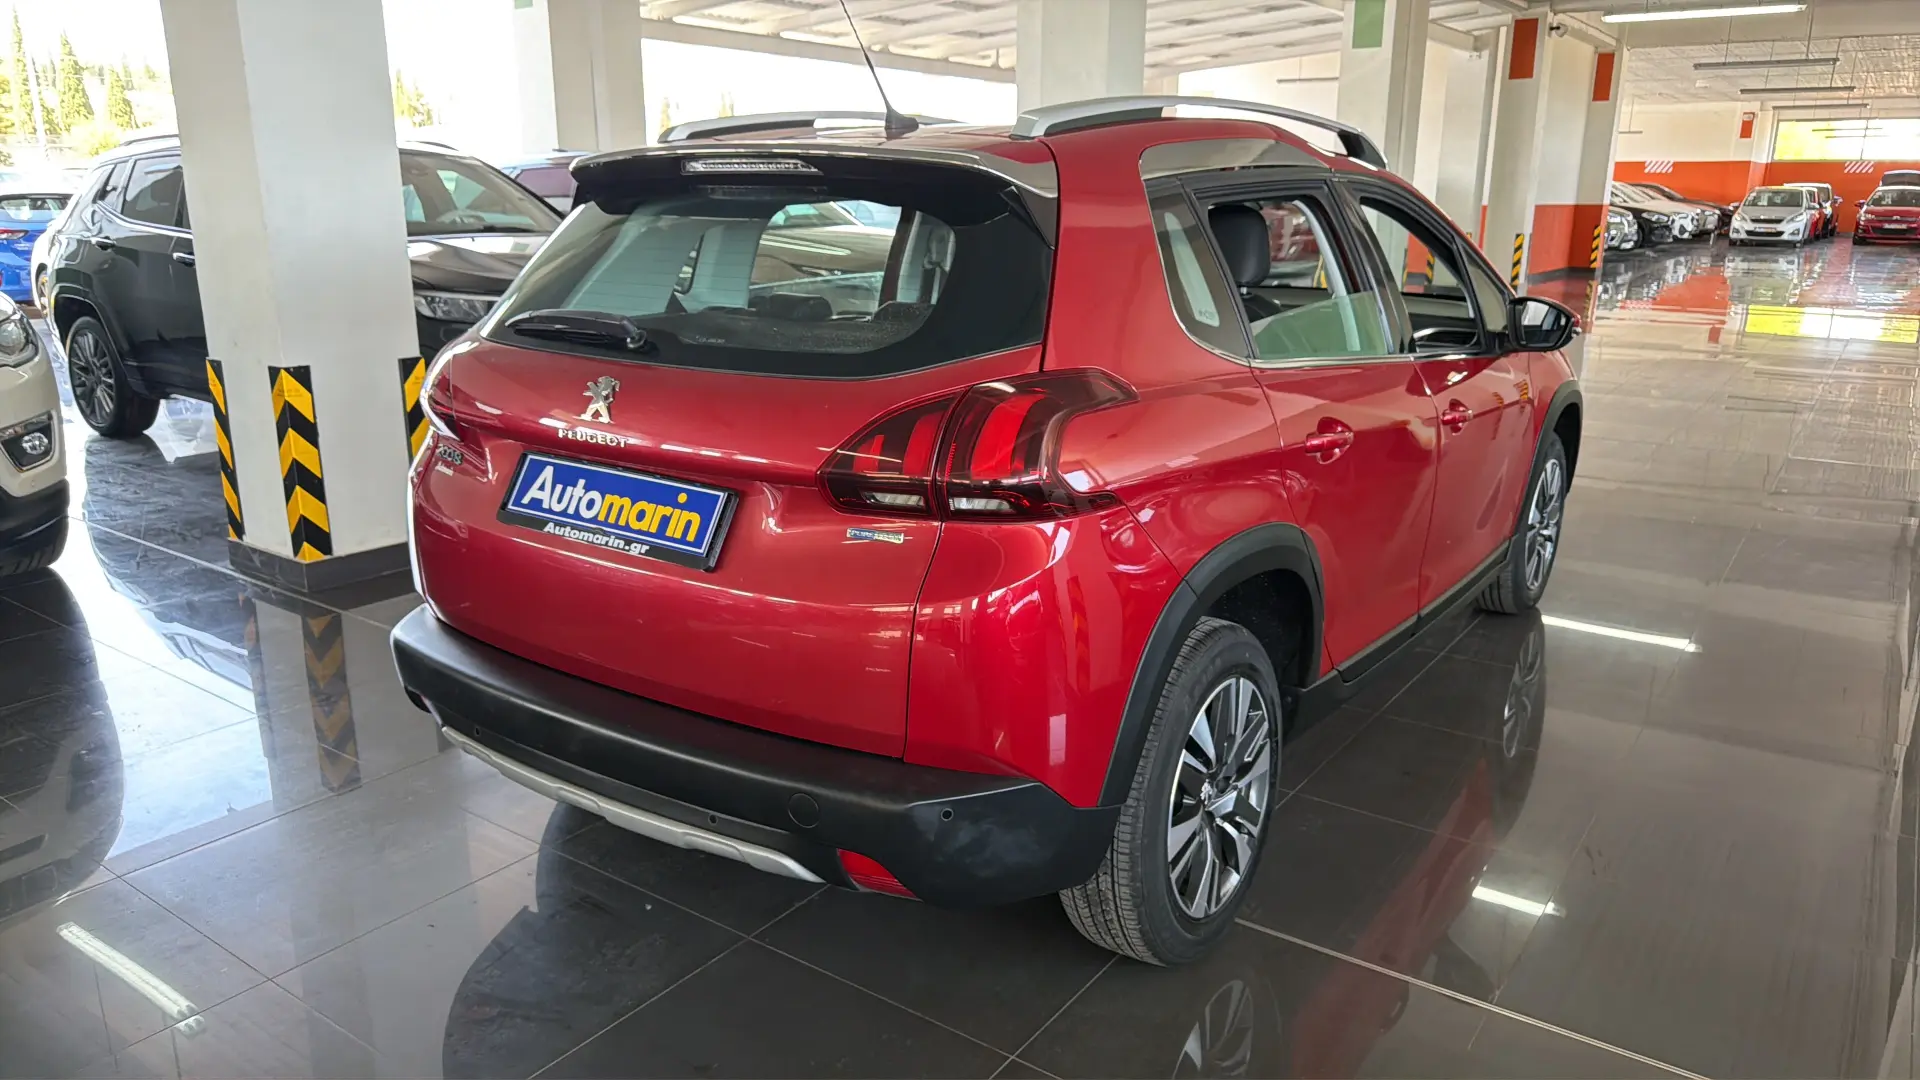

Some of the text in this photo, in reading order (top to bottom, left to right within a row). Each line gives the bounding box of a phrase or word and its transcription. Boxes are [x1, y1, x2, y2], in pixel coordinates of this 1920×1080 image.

[558, 428, 629, 448] PEUGEOT
[521, 465, 701, 542] Automarin
[543, 522, 650, 554] Automarin.gr
